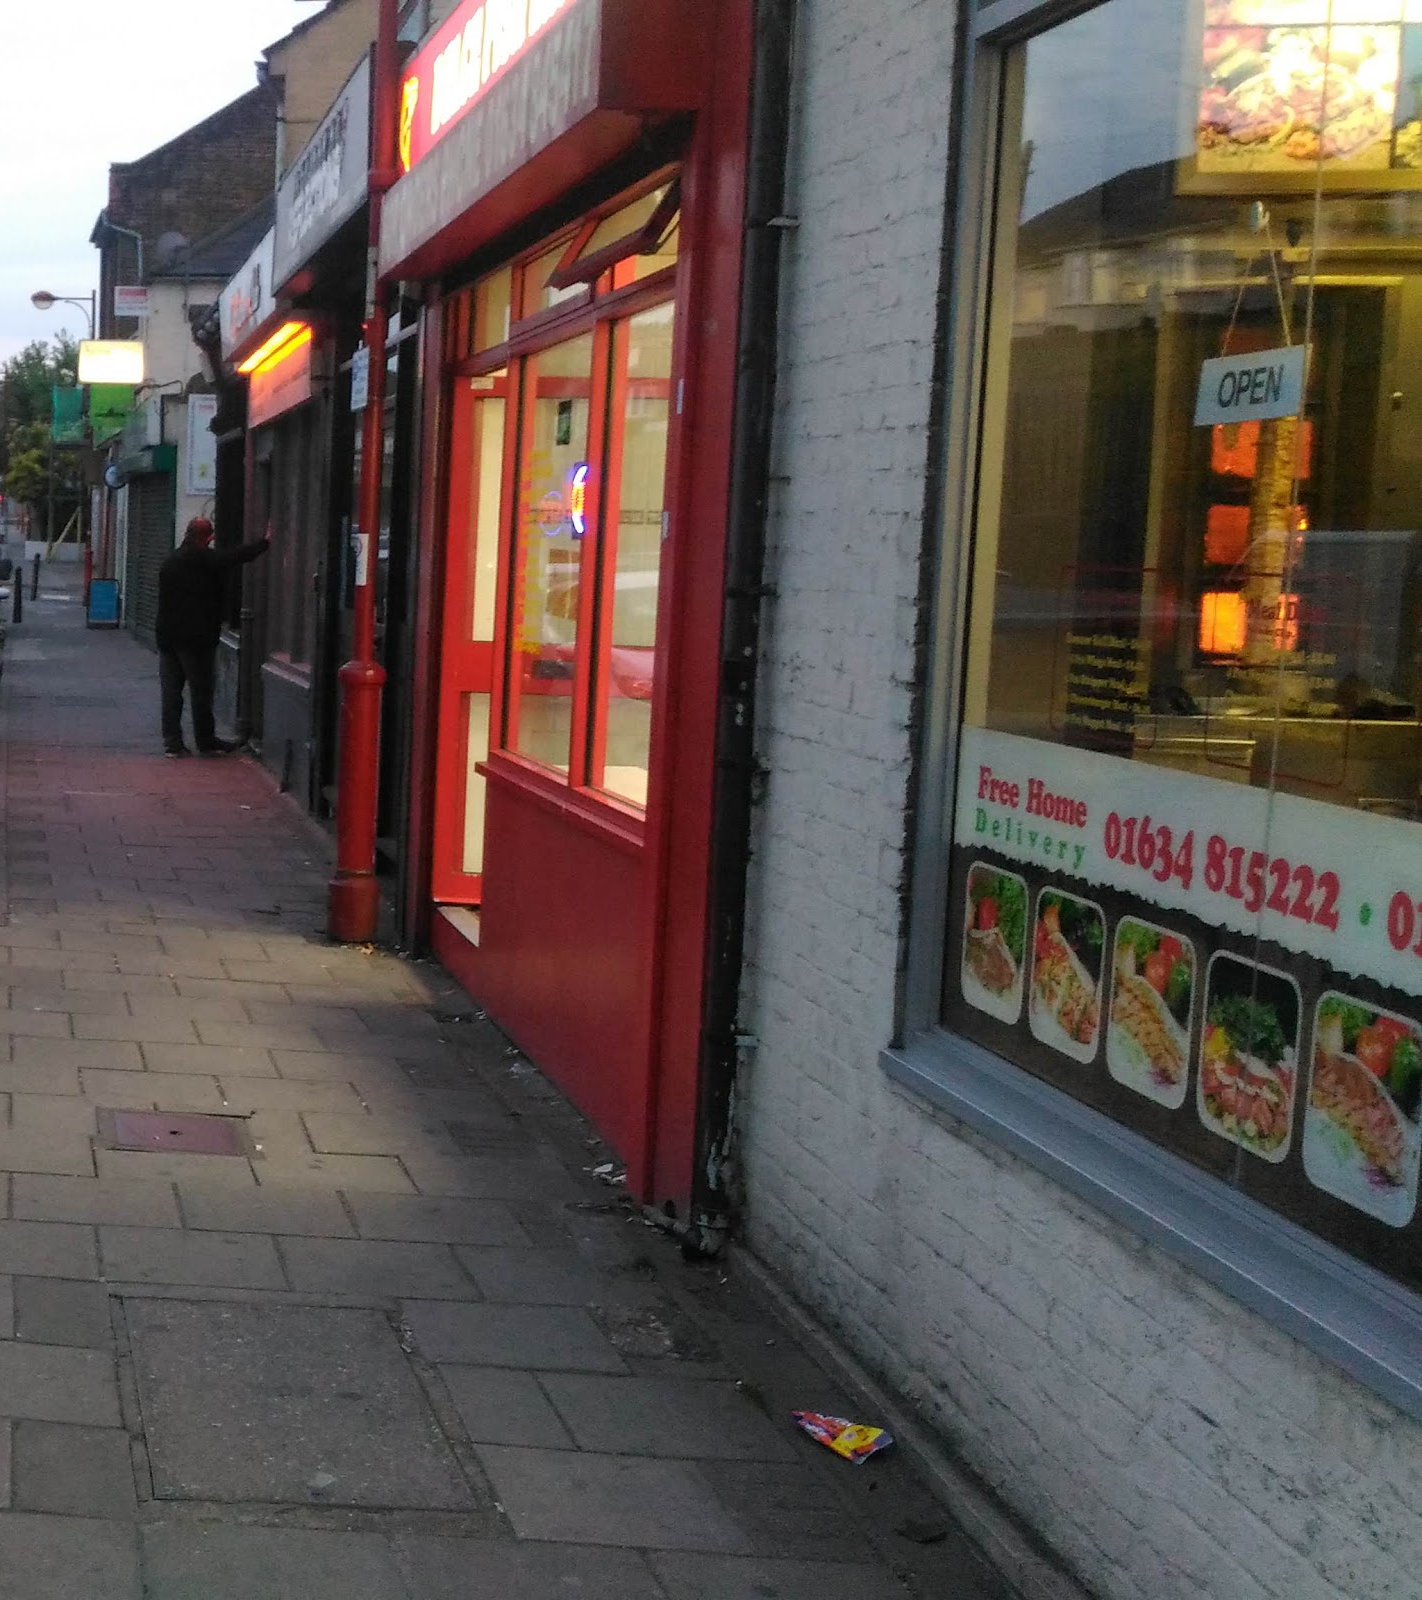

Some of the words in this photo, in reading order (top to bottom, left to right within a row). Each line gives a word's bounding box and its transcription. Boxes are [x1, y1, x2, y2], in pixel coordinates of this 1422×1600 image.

[1218, 364, 1284, 408] OPEN
[978, 765, 1019, 808] Free
[1026, 778, 1088, 828] Home
[975, 807, 1086, 870] Delivery
[1104, 812, 1194, 890] 01634
[1204, 835, 1340, 932] 815222
